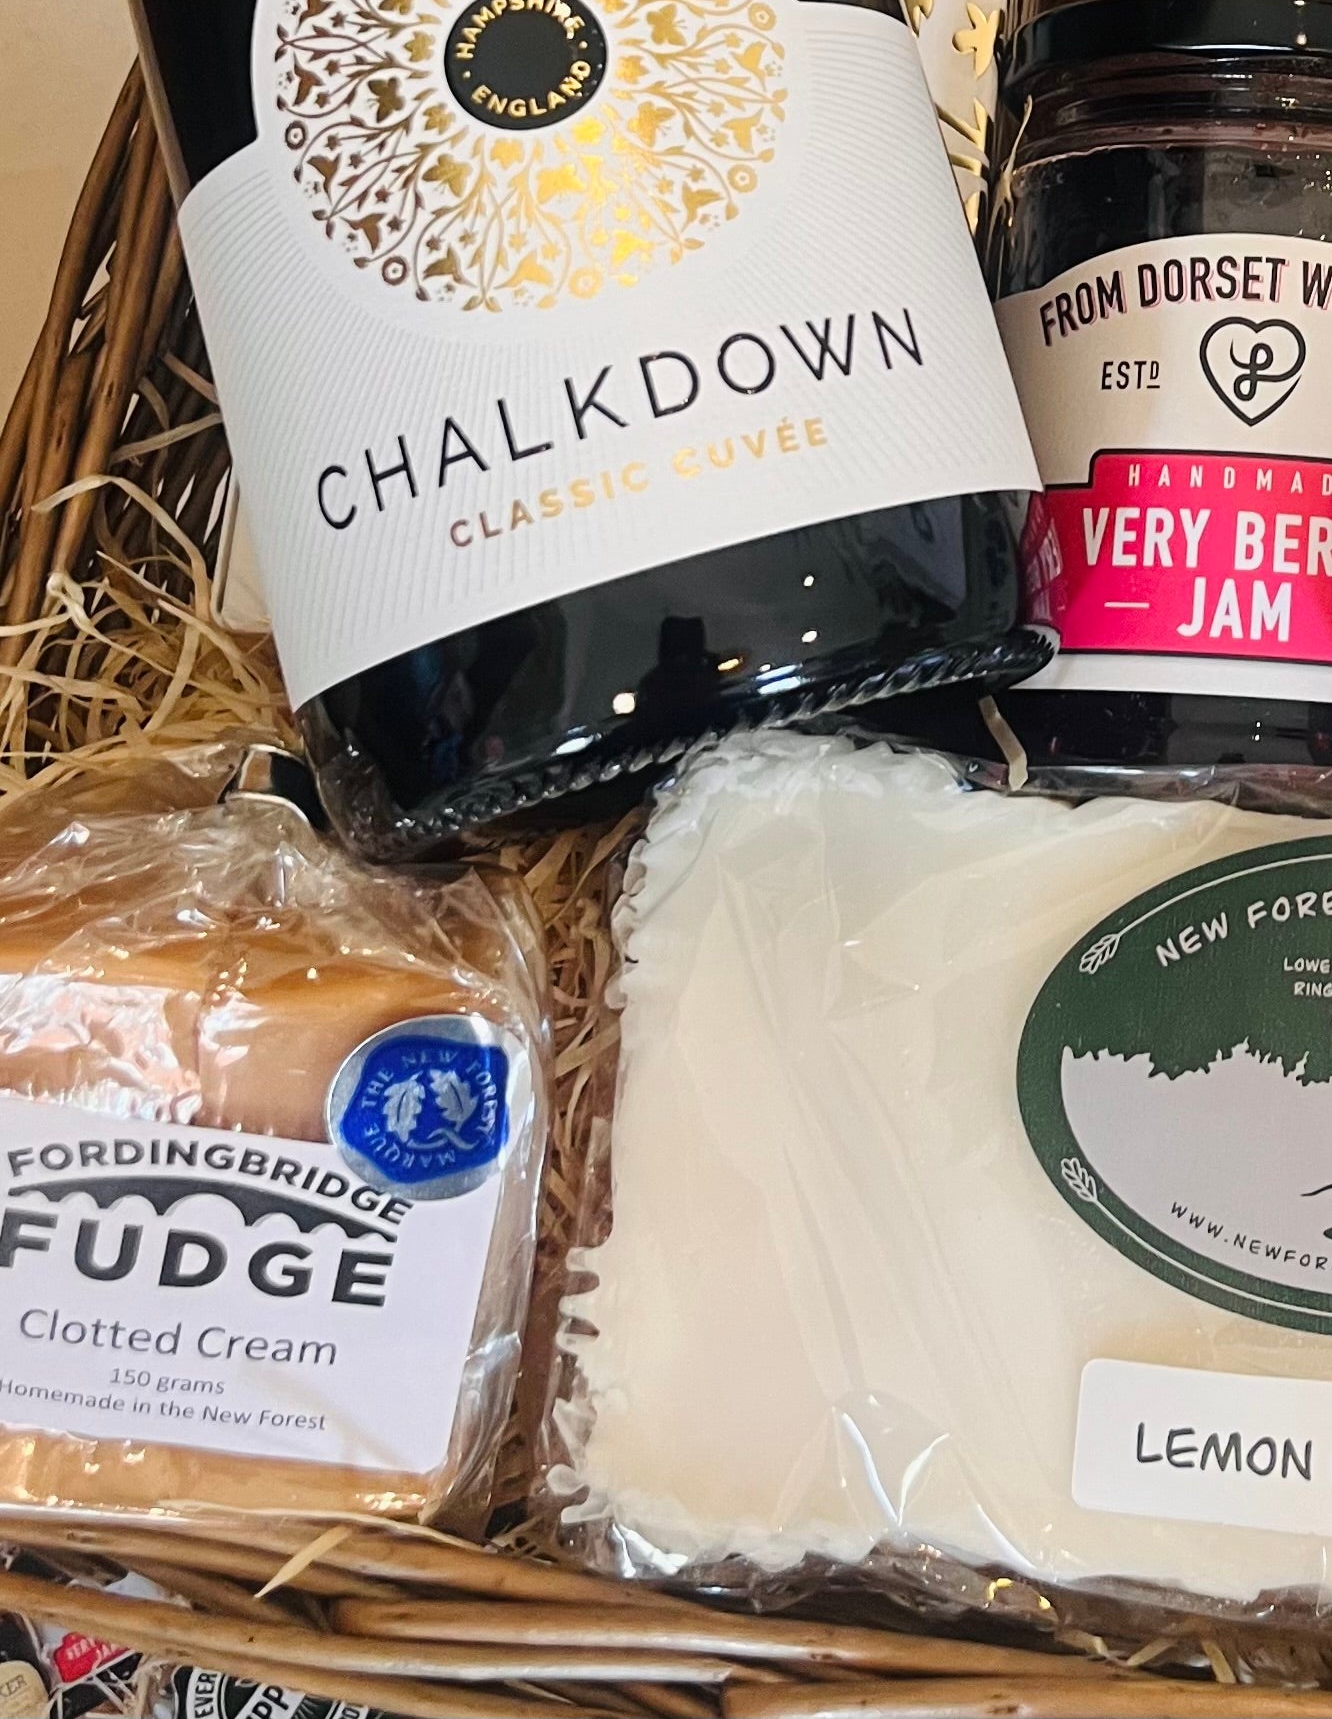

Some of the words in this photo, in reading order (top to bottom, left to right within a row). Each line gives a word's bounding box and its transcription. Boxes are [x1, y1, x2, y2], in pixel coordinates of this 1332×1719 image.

[470, 60, 592, 119] ENGLAND
[1038, 269, 1128, 348] FROM
[1137, 255, 1288, 311] DORSET
[316, 305, 926, 532] CHALKDOWN
[449, 460, 649, 549] CLASSIC
[672, 415, 831, 479] CUVÉE
[1082, 507, 1212, 569] VERY
[1177, 576, 1292, 643] JAM
[1154, 910, 1231, 968] NEW
[7, 1137, 415, 1226] FORDINGBRIDGE
[0, 1206, 396, 1308] FUDGE
[19, 1307, 182, 1356] Clotted
[198, 1325, 338, 1366] Cream
[0, 1378, 125, 1412] Homemade
[132, 1395, 151, 1414] in
[159, 1399, 195, 1419] the
[202, 1404, 252, 1425] New
[258, 1409, 327, 1431] Forest
[109, 1366, 151, 1387] 150
[156, 1375, 226, 1395] grams
[1135, 1421, 1313, 1482] LEMON
